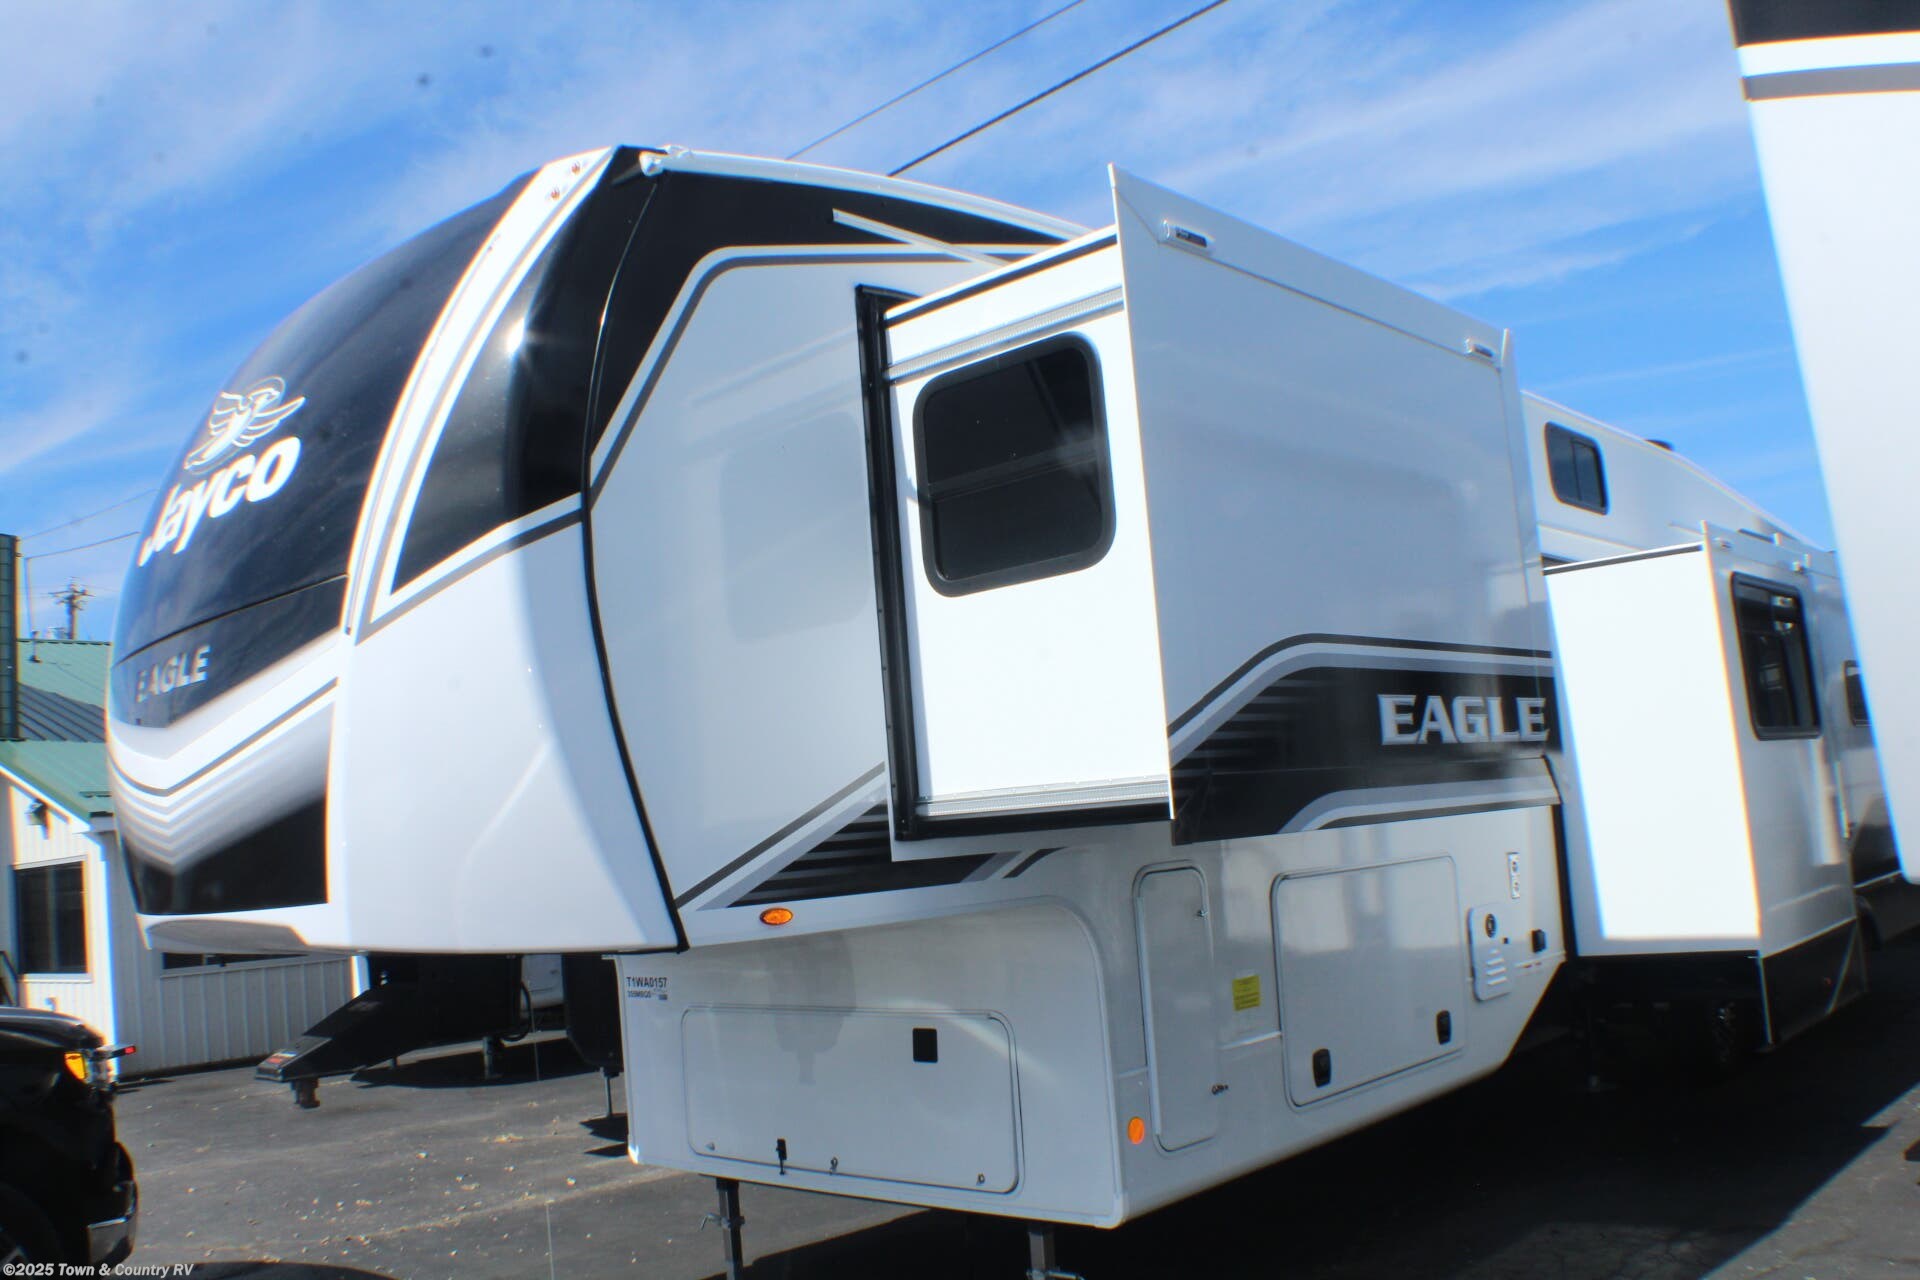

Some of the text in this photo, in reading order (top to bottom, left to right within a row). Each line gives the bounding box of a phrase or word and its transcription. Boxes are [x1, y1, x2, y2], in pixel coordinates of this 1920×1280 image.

[138, 436, 301, 567] Jayco
[135, 645, 210, 702] EAGLE
[1378, 694, 1550, 745] EAGLE
[626, 976, 668, 988] T1WA0157
